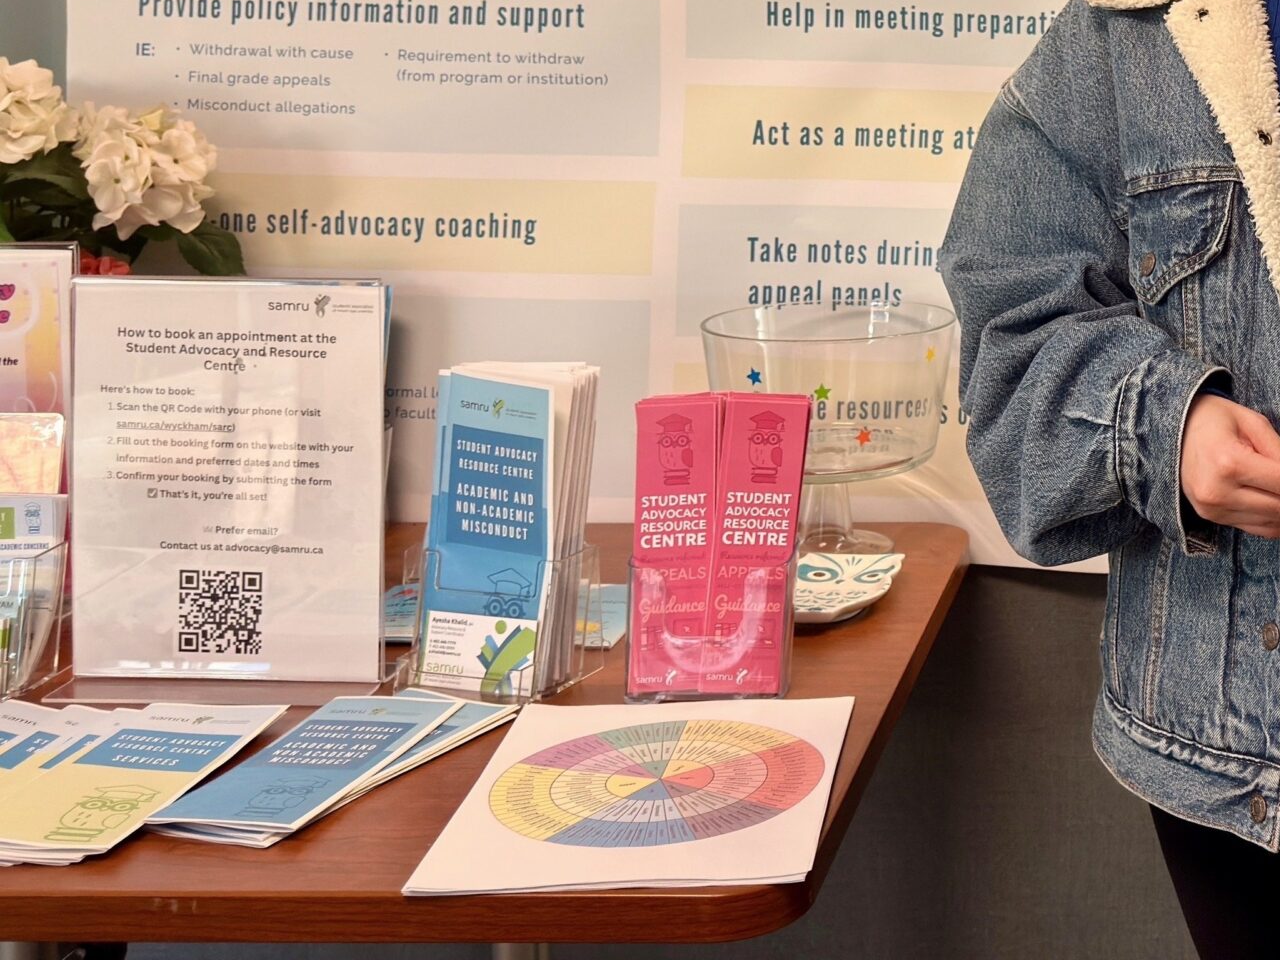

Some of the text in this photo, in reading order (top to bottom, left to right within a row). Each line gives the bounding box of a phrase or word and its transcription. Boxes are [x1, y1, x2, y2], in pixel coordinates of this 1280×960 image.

[449, 1, 486, 26] and
[497, 4, 585, 32] support
[766, 1, 1056, 39] Help in meeting preparat
[136, 43, 155, 56] IE:
[189, 44, 353, 60] Withdrawal with cause
[397, 49, 584, 66] Requirement to withdraw
[188, 72, 330, 88] Final grade appeals
[396, 70, 608, 88] (from program or institution)
[187, 99, 355, 116] Misconduct allegations
[753, 120, 789, 145] Act
[800, 127, 823, 145] as
[834, 128, 844, 146] a
[855, 123, 943, 154] meeting
[748, 237, 796, 263] Take
[808, 240, 867, 264] notes
[748, 280, 902, 311] appeal panels
[268, 301, 309, 312] samru
[118, 327, 337, 344] How to book an appointment at the
[126, 343, 326, 358] Student Advocacy and Resource
[3, 357, 18, 365] the
[204, 360, 245, 371] Centre
[100, 384, 195, 396] Here's how to book:
[117, 403, 140, 412] Scan
[143, 404, 158, 412] the
[161, 404, 175, 413] QR
[177, 405, 202, 414] Code
[204, 405, 225, 414] with
[227, 408, 249, 417] your
[252, 407, 282, 417] phone
[284, 407, 299, 417] (or
[301, 408, 320, 417] visit
[460, 399, 489, 412] samru
[457, 440, 537, 462] STUDENT ADVOCACY
[459, 458, 533, 479] RESOURCE CENTRE
[160, 491, 267, 501] That's it, you're all set!
[457, 483, 534, 506] ACADEMIC AND
[641, 493, 707, 507] STUDENT
[727, 492, 792, 505] STUDENT
[456, 501, 534, 522] NON-ACADEMIC
[641, 507, 706, 521] ADVOCACY
[725, 506, 790, 517] ADVOCACY
[215, 526, 278, 535] Prefer email?
[462, 519, 528, 540] MISCONDUCT
[640, 519, 707, 533] RESOURCE
[723, 519, 789, 530] RESOURCE
[640, 533, 707, 549] CENTRE
[722, 531, 788, 546] CENTRE
[160, 542, 197, 551] Contact
[201, 543, 211, 551] us
[225, 544, 323, 555] advocacy@samru.ca
[639, 596, 705, 622] Guidance
[715, 595, 780, 619] Guidance
[112, 755, 179, 766] SERVICES
